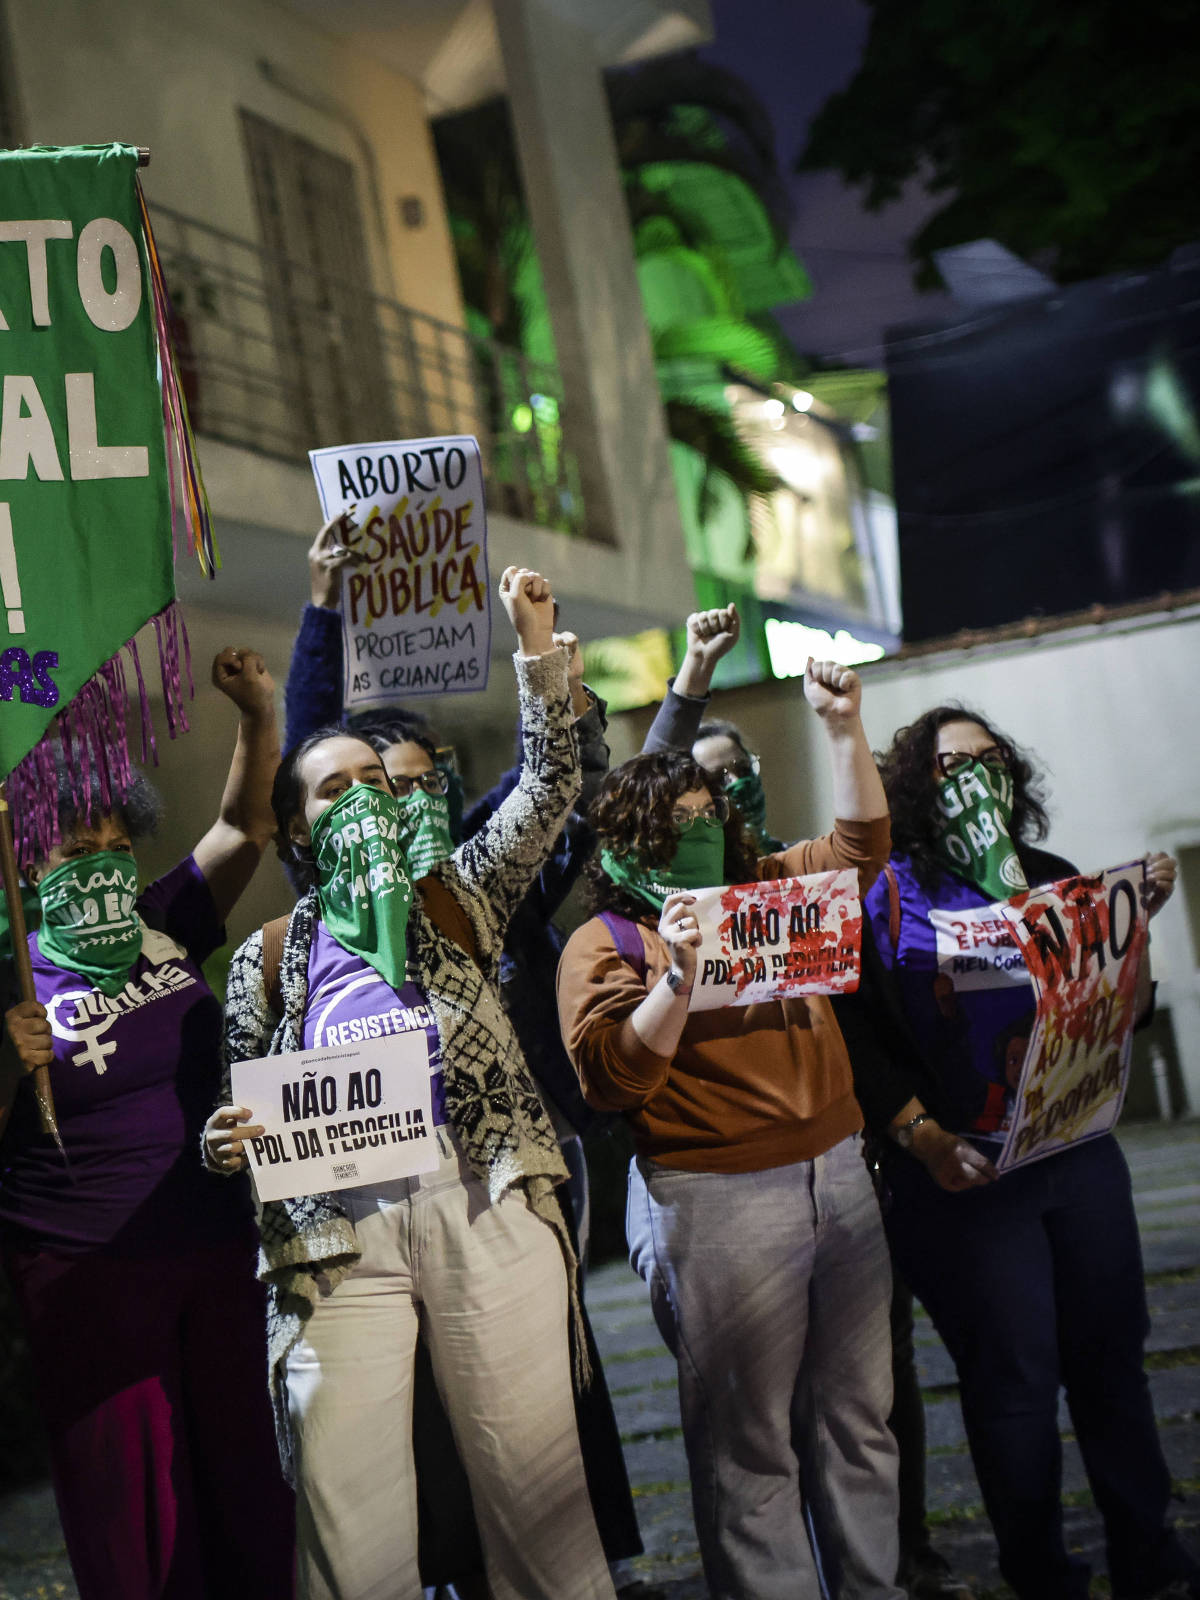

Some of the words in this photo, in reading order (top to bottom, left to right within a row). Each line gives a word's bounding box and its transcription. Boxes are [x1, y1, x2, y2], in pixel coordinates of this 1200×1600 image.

[337, 446, 467, 501] ABORTO
[364, 500, 474, 564] SAÚDE
[347, 553, 485, 626] PÚBLICA
[354, 622, 476, 662] PROTEJAM
[352, 673, 371, 693] AS
[380, 658, 480, 691] CRIANÇAS
[341, 795, 380, 821] NEM
[731, 904, 780, 951] NÃO
[789, 902, 821, 942] AO
[701, 958, 738, 986] PDL
[743, 955, 768, 984] DA
[952, 956, 989, 973] MEU
[993, 953, 1028, 971] COR
[282, 1071, 338, 1124] NÃO
[347, 1068, 383, 1112] AO
[250, 1133, 292, 1167] PDL
[293, 1127, 325, 1162] DA
[325, 1108, 428, 1156] PEDOFILIA
